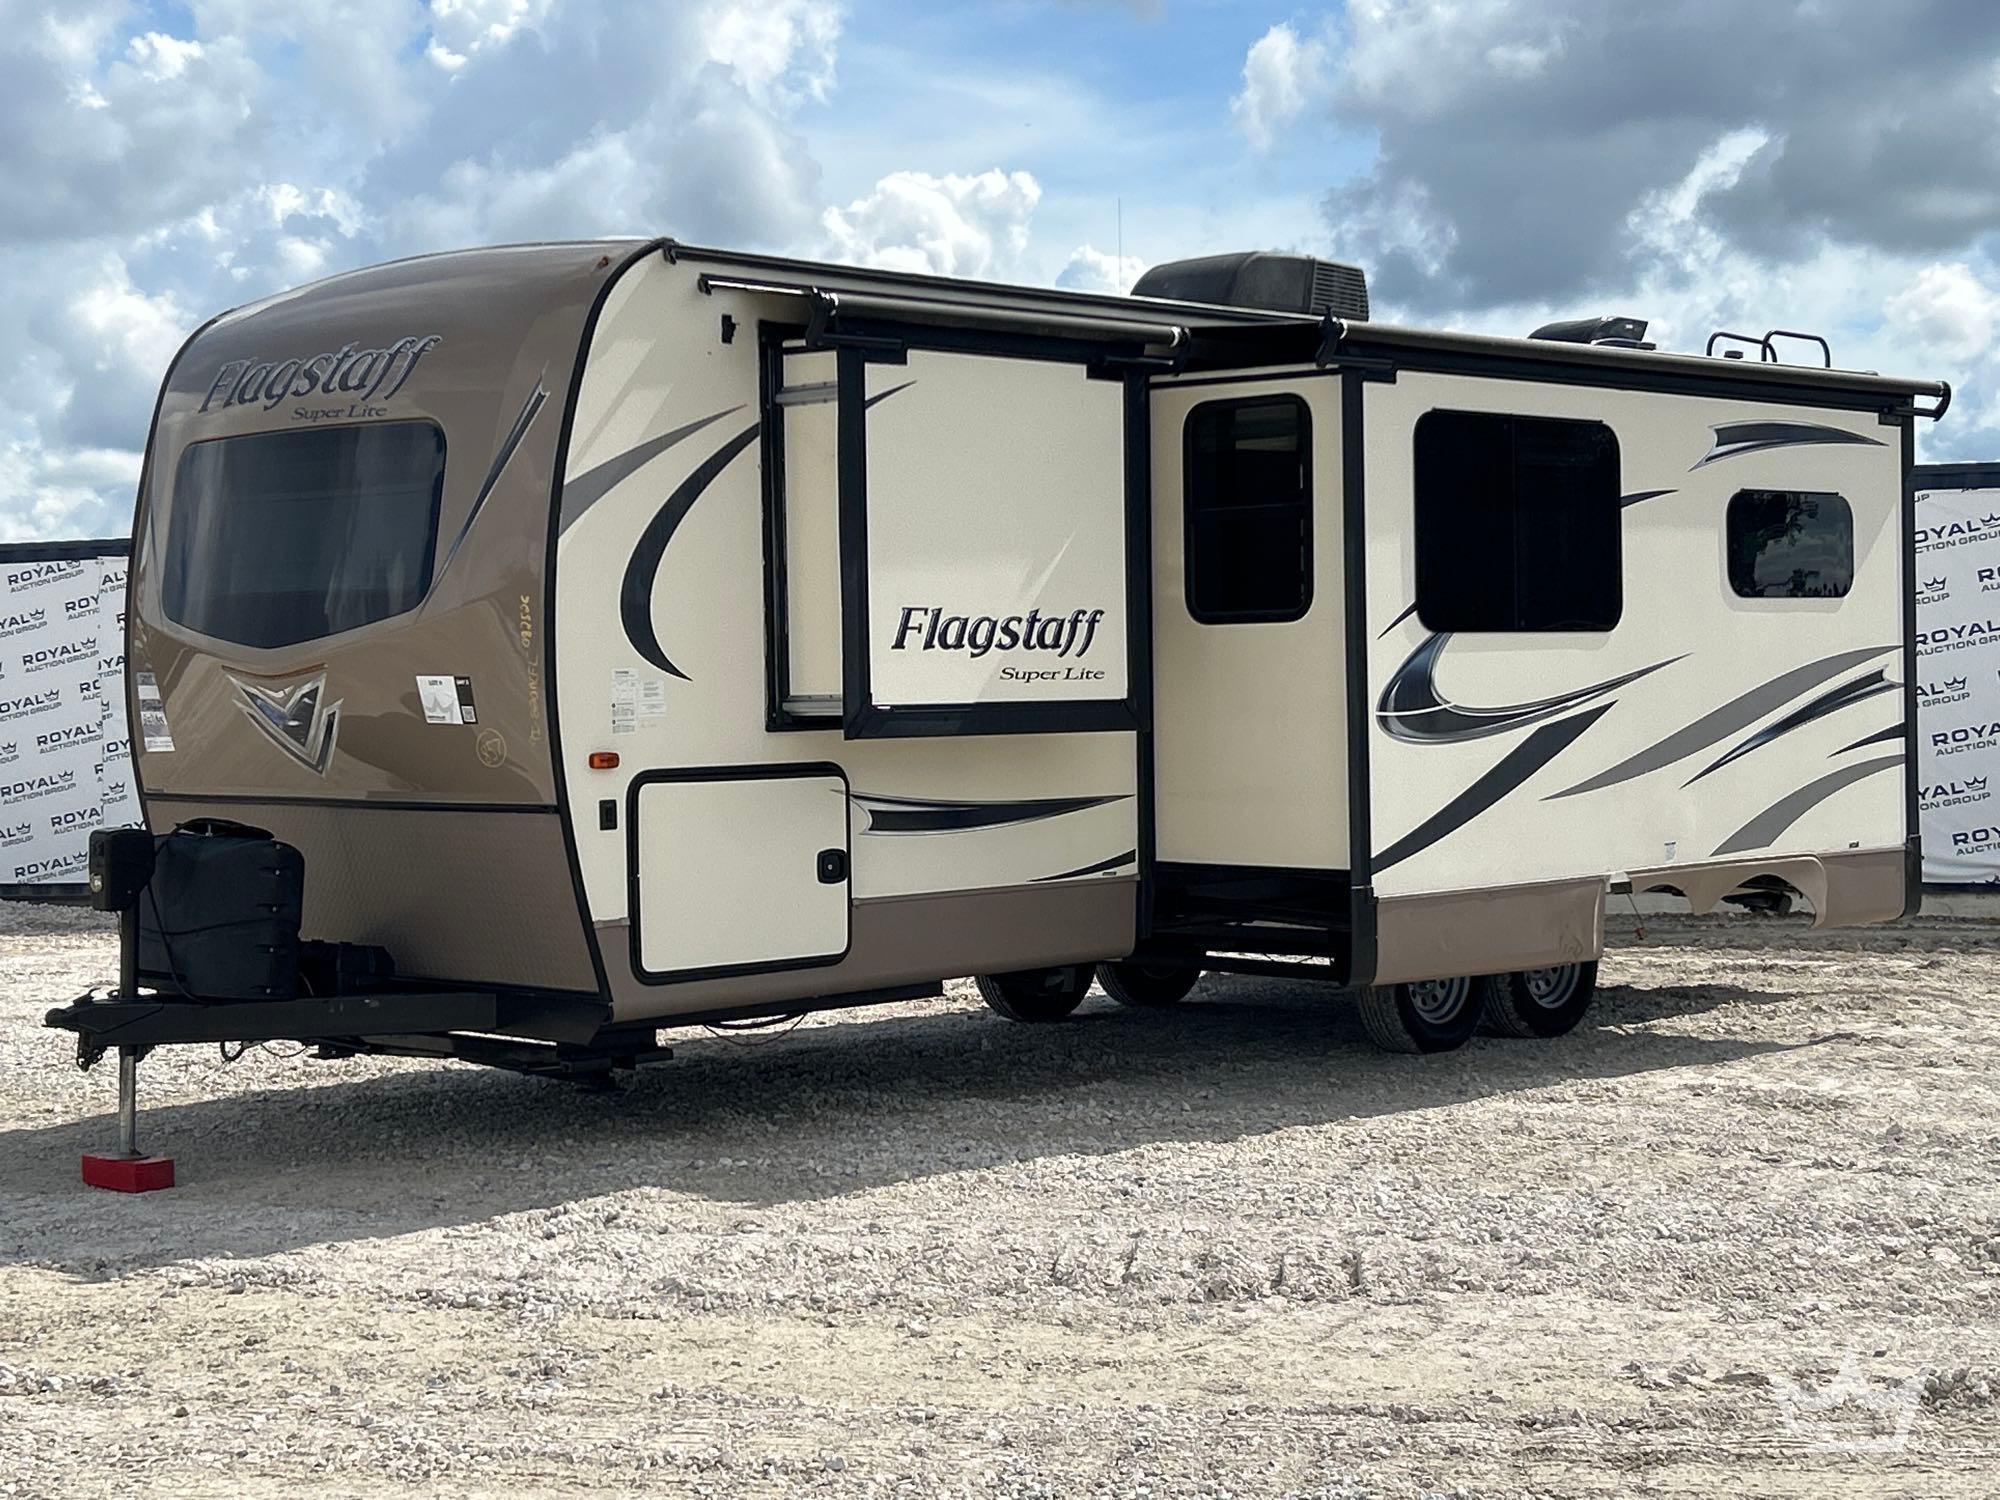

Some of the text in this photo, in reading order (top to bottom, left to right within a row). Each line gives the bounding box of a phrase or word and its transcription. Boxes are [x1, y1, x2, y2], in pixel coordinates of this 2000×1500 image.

[198, 335, 443, 414] Flagstaff
[292, 404, 387, 422] Super Lite
[1915, 520, 1981, 543] OYAL
[1915, 539, 1957, 554] CTION
[7, 562, 67, 586] ROYAL
[10, 577, 51, 593] AUCTION
[52, 568, 84, 583] GROUP
[65, 594, 100, 612] ROY
[0, 614, 30, 631] YAL
[15, 620, 48, 635] GROUP
[891, 607, 1105, 658] Flagstaff
[22, 642, 81, 666] ROYAL
[1916, 638, 1977, 658] AUCTION
[25, 658, 66, 673] AUCTION
[66, 650, 100, 663] GROUP
[1000, 667, 1105, 683] Super Lite
[0, 694, 45, 714] OYAL
[1922, 692, 1971, 708] GROUP
[0, 701, 62, 722] CTION GROUP
[36, 724, 96, 746] ROYAL
[1931, 722, 2000, 747] ROYA
[39, 738, 81, 754] AUCTION
[1935, 739, 1998, 757] AUCTION
[0, 754, 19, 764] OUP
[1, 775, 59, 797] ROYAL
[3, 782, 77, 805] AUCTION GROUP
[1918, 782, 1965, 801] YAL
[1942, 792, 1991, 807] GROUP
[50, 807, 101, 827] ROYA
[54, 820, 95, 835] AUCTION
[1952, 827, 2000, 846] ROY
[1, 835, 34, 848] GROUP
[1956, 842, 2000, 856] AUCTI
[14, 856, 73, 878] ROYAL
